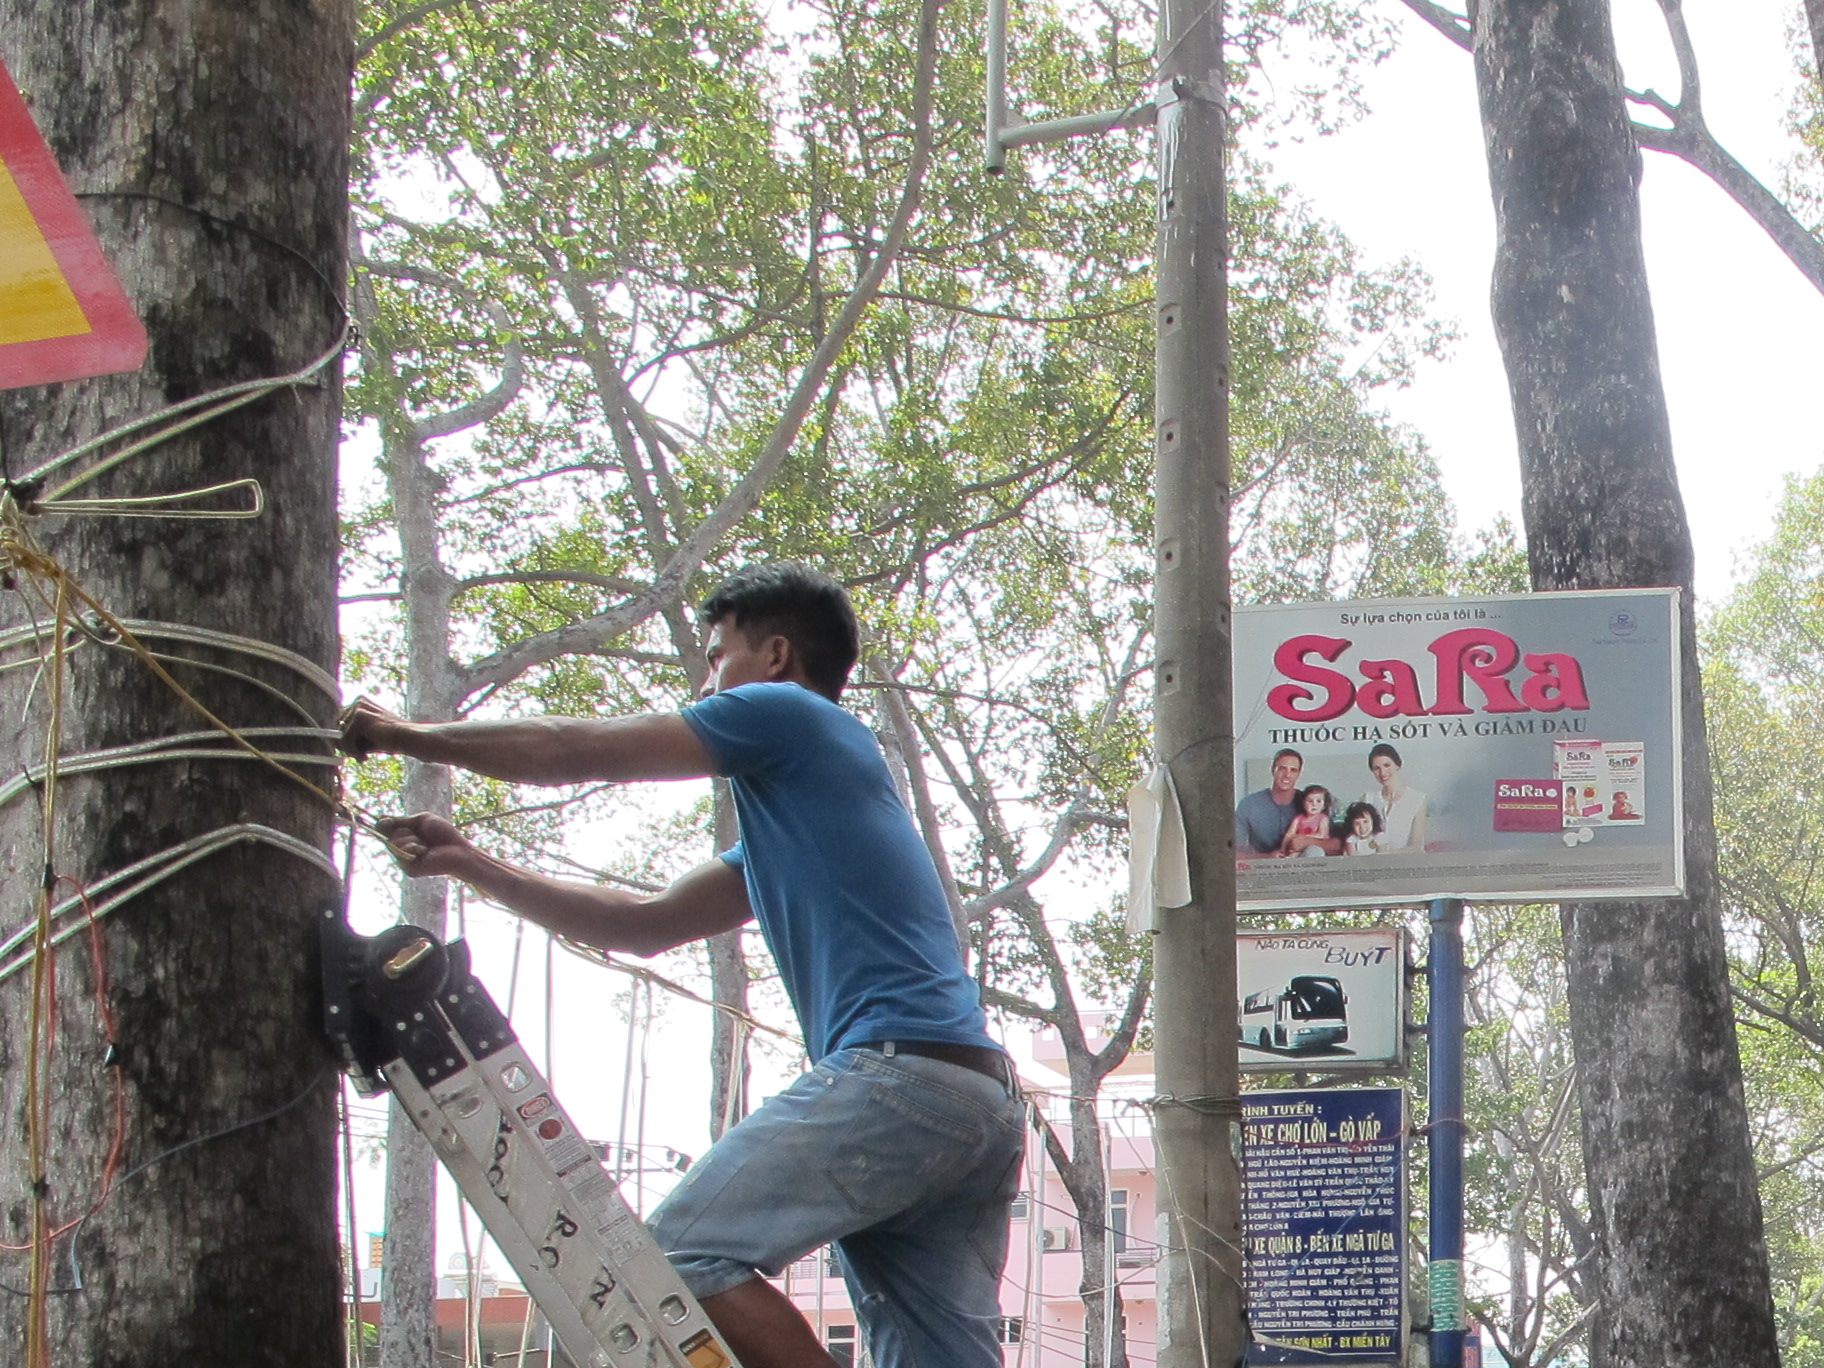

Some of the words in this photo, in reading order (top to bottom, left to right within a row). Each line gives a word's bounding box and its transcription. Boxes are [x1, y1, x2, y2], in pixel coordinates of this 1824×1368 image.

[1340, 612, 1360, 626] Sự
[1362, 611, 1385, 626] lựa
[1388, 610, 1422, 626] chọn
[1425, 610, 1450, 623] của
[1454, 608, 1471, 621] tôi
[1474, 608, 1487, 620] là
[1266, 628, 1590, 722] SaRa
[1268, 719, 1346, 745] THUỐC
[1352, 724, 1381, 744] HẠ
[1389, 715, 1433, 741] SỐT
[1438, 717, 1468, 738] VÀ
[1475, 716, 1532, 737] GIẢM
[1537, 717, 1588, 735] ĐAU
[1499, 784, 1545, 797] SaRa
[1282, 939, 1295, 949] TA
[1324, 946, 1392, 966] BUÝT
[1272, 1101, 1314, 1116] TUYẾN
[1260, 1124, 1274, 1145] XE
[1278, 1120, 1303, 1145] CHỢ
[1304, 1116, 1327, 1143] LỚN
[1340, 1115, 1355, 1143] GÒ
[1358, 1112, 1381, 1141] VẤP
[1253, 1237, 1266, 1254] XE
[1268, 1232, 1294, 1257] QUẬN
[1310, 1228, 1330, 1252] BẾN
[1331, 1234, 1344, 1252] XE
[1346, 1230, 1365, 1251] NGÃ
[1381, 1233, 1395, 1250] GA
